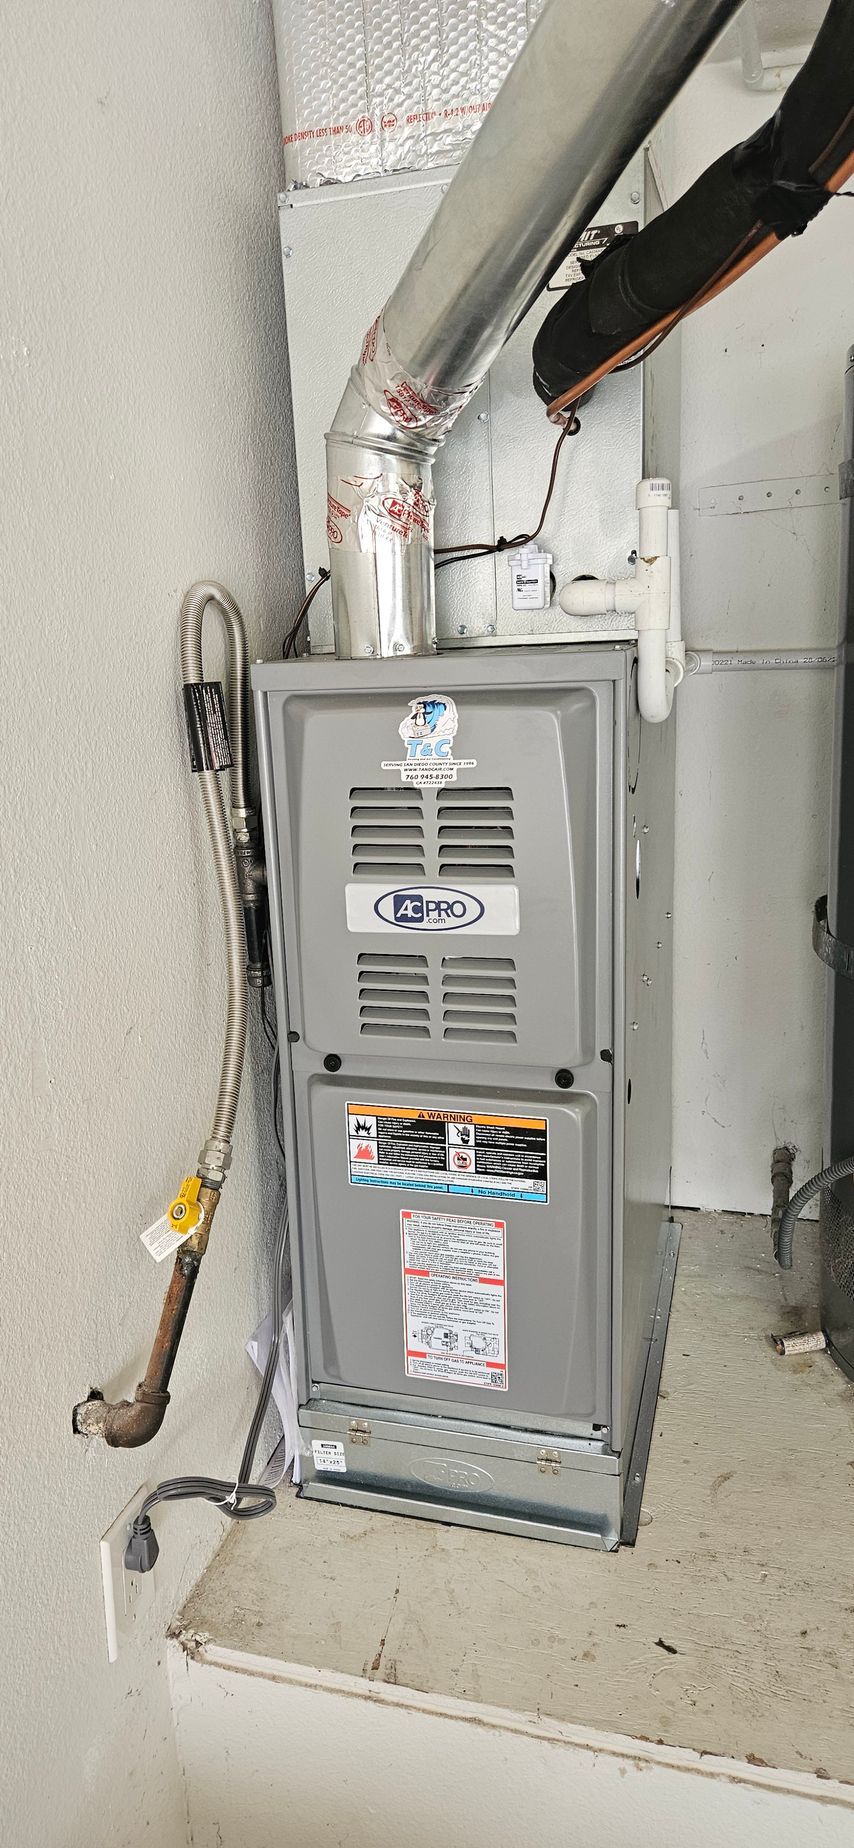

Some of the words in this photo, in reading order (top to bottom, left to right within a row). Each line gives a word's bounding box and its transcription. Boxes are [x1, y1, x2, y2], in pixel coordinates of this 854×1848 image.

[407, 739, 450, 757] T&C
[426, 1112, 473, 1123] WARNING
[487, 1190, 516, 1198] Handhold
